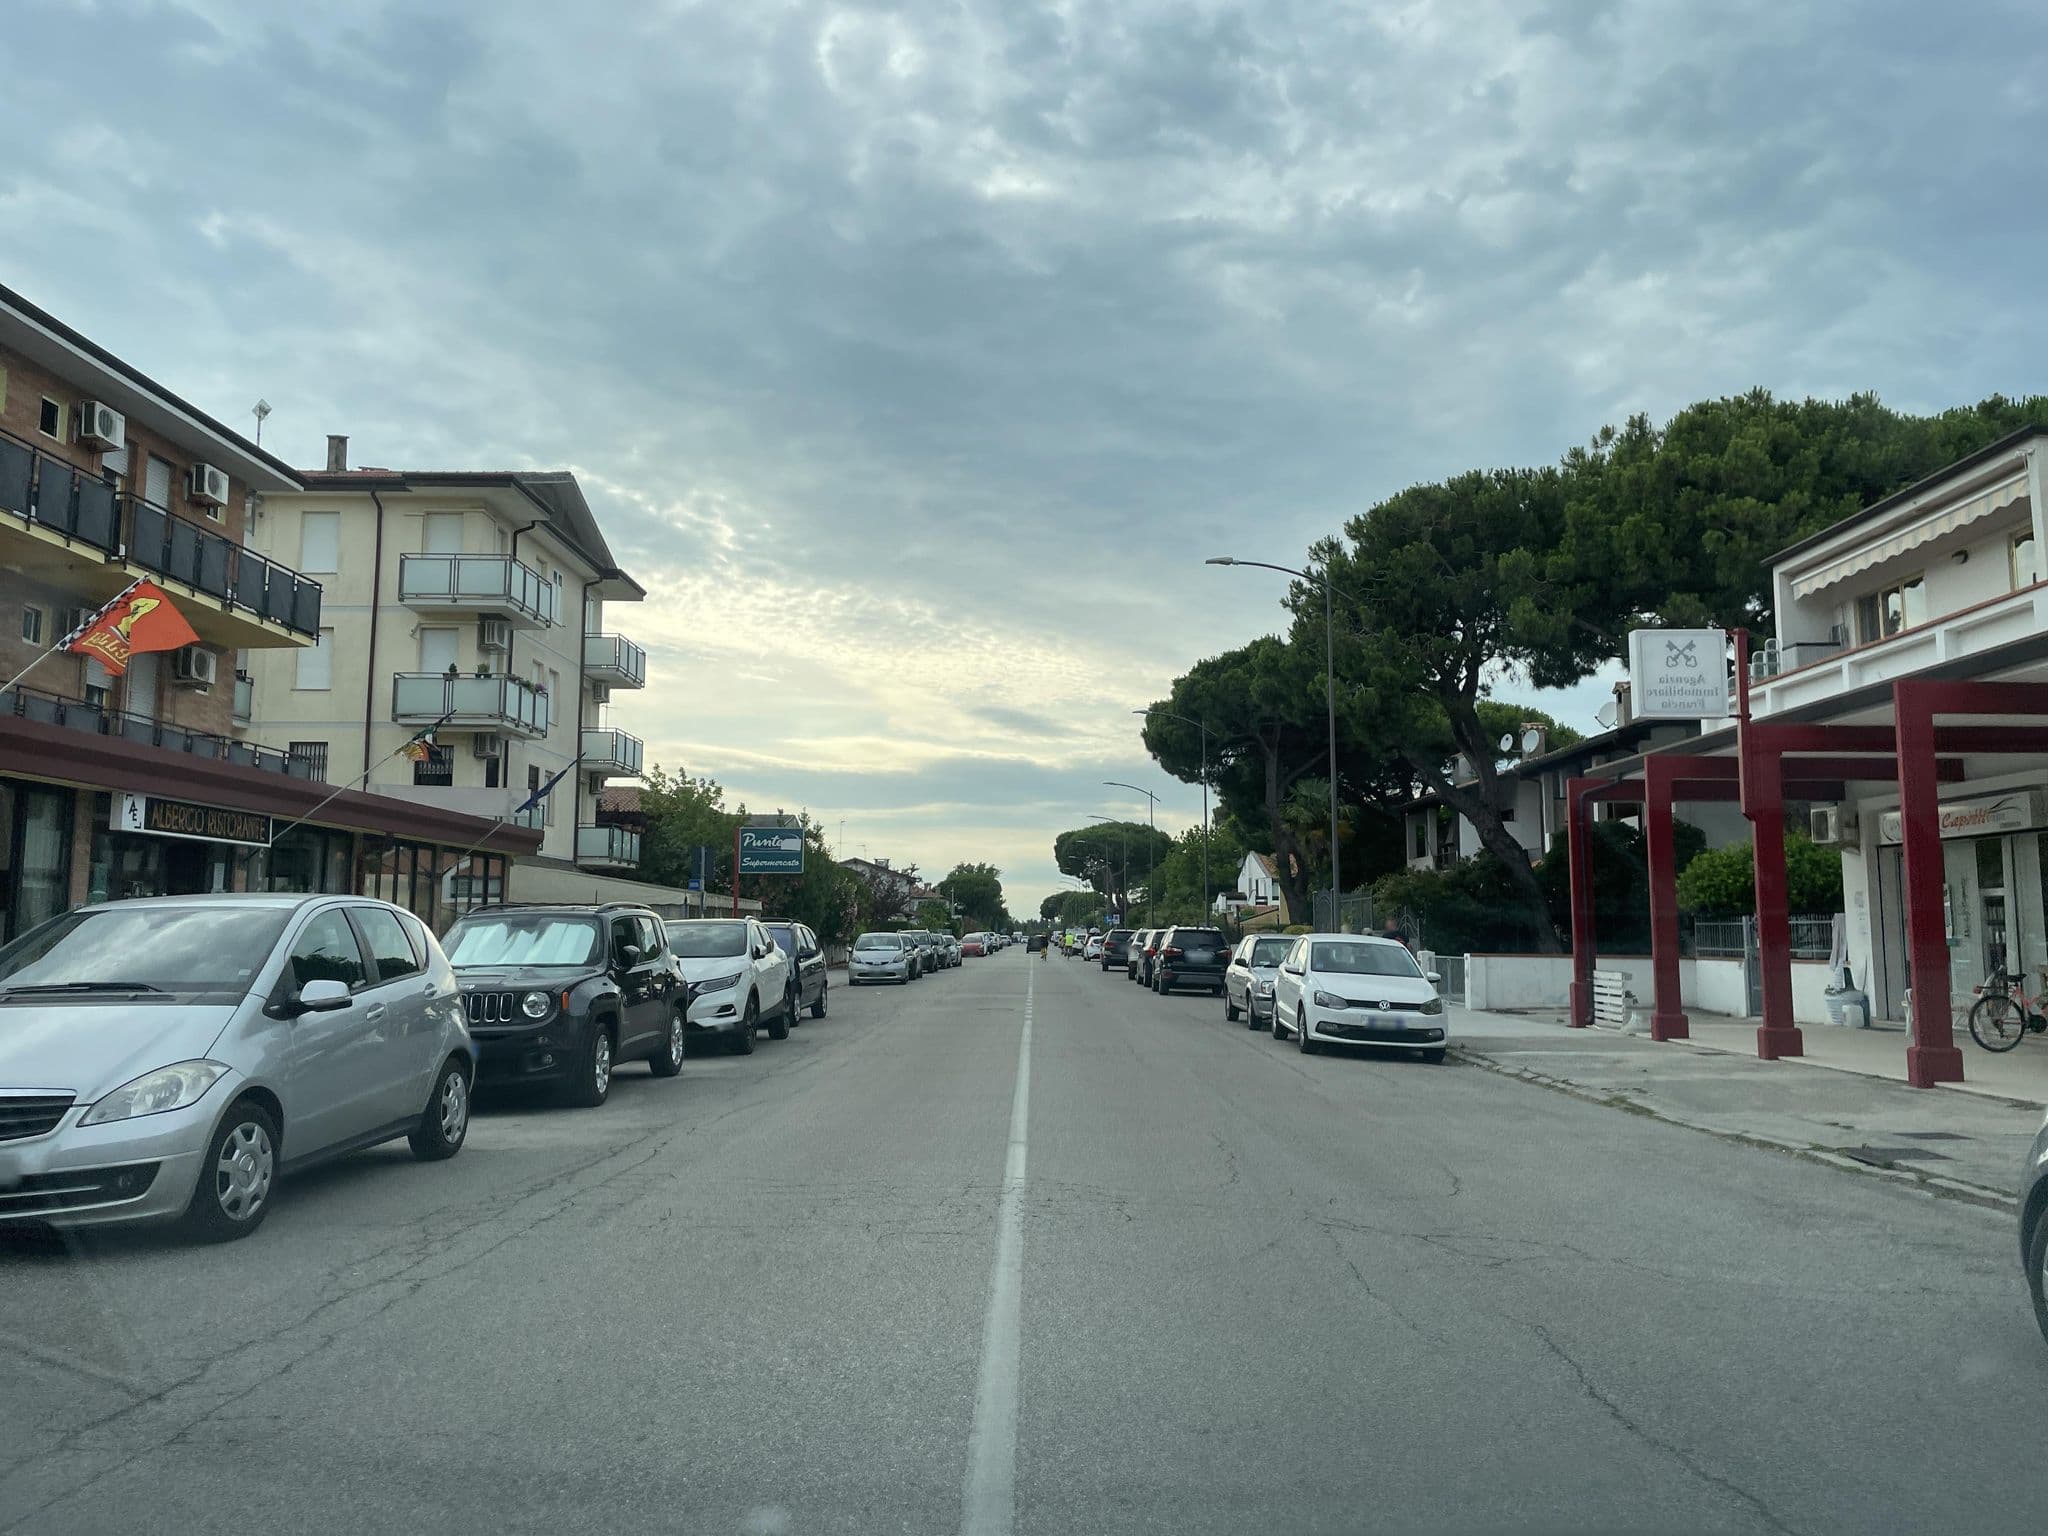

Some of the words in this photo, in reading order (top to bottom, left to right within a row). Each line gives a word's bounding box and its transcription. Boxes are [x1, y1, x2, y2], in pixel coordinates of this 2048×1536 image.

[151, 802, 205, 833] ALBERGO
[207, 809, 266, 841] RISTORANTE
[741, 857, 800, 868] Supermercato
